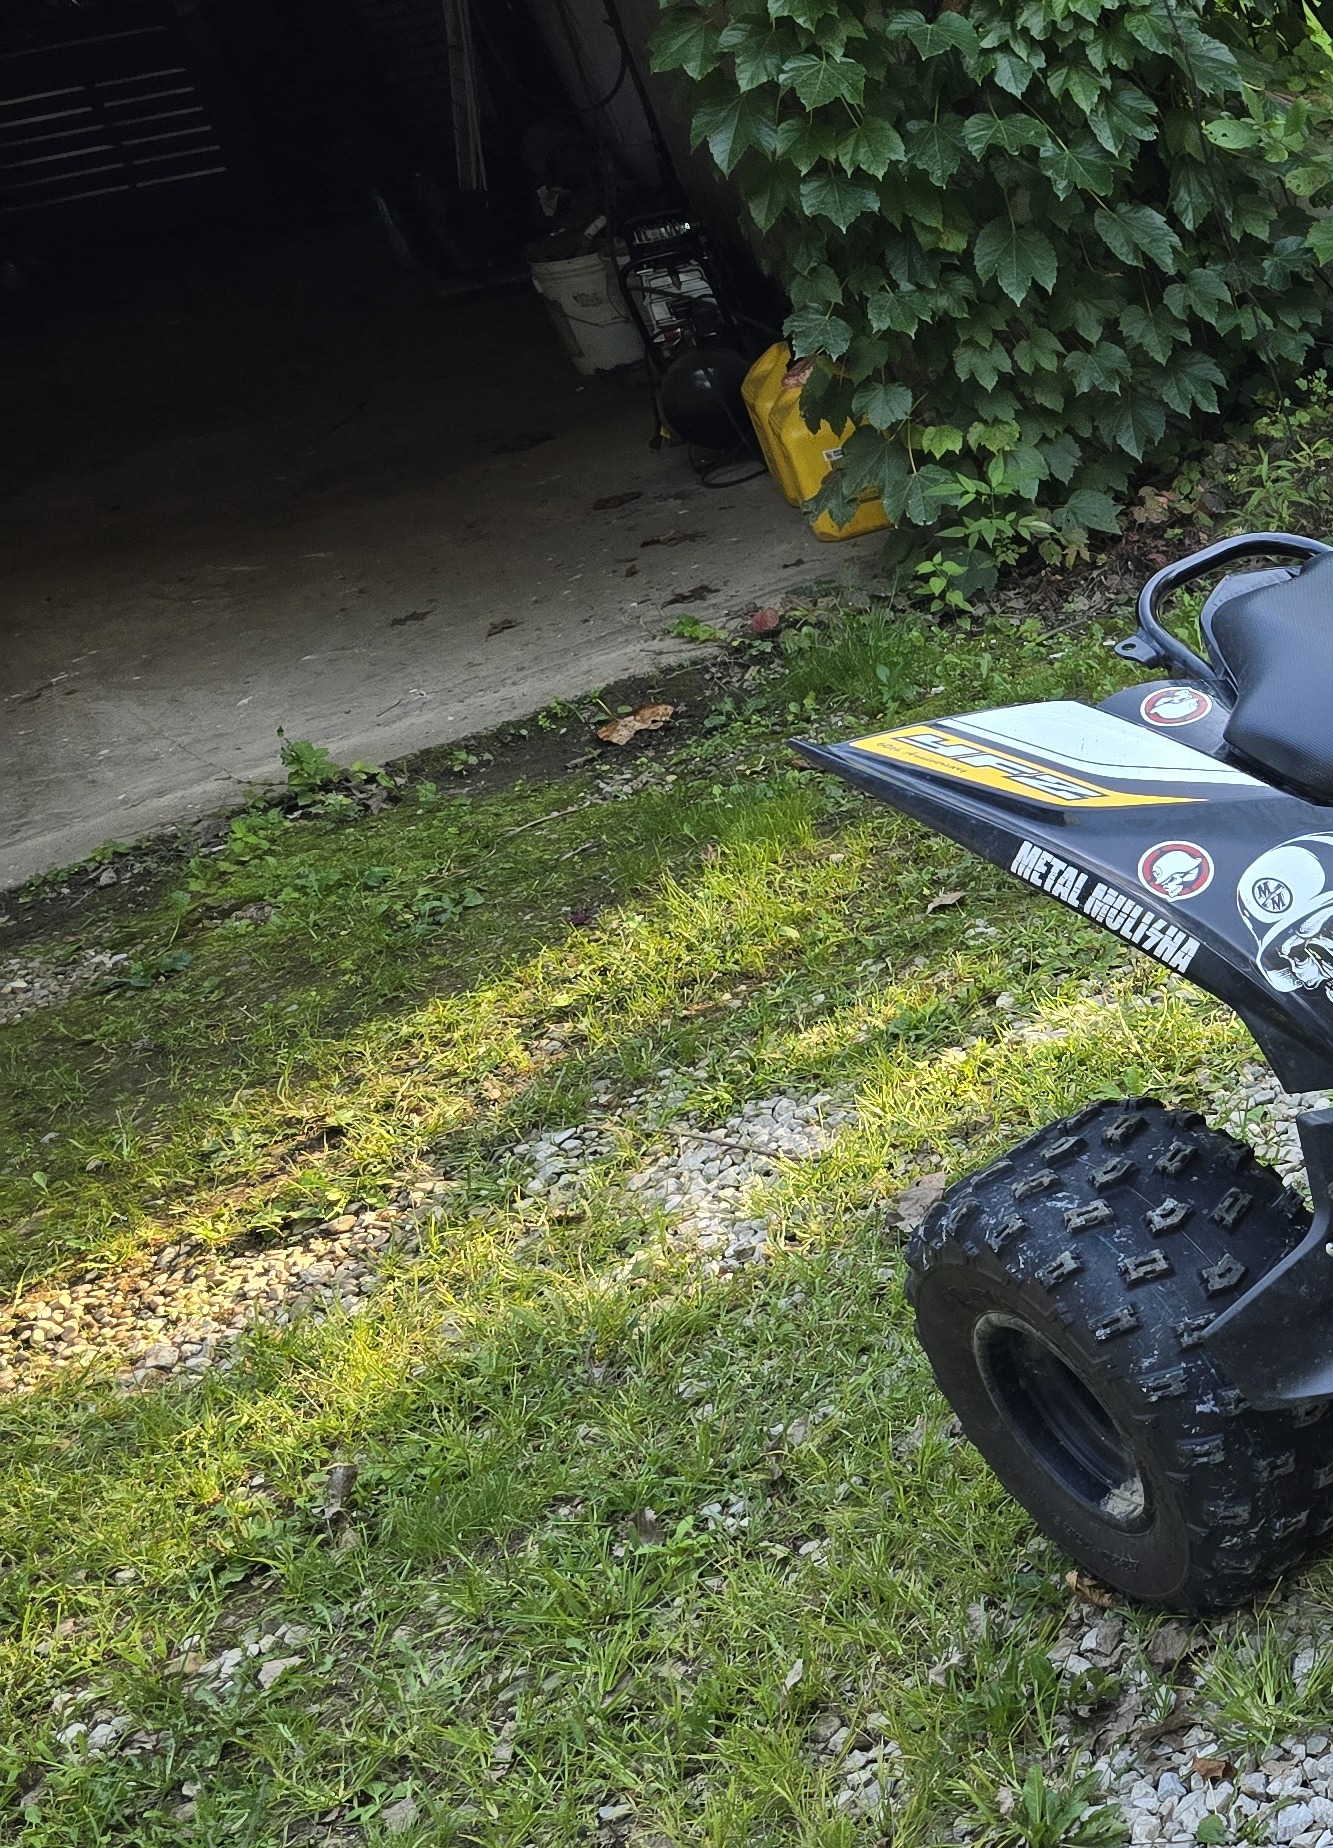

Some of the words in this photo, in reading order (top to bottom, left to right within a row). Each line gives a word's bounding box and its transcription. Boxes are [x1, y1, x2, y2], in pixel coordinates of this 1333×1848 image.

[894, 733, 1109, 800] YFZ
[1010, 840, 1089, 908] METAL
[1083, 882, 1201, 974] MULISHA
